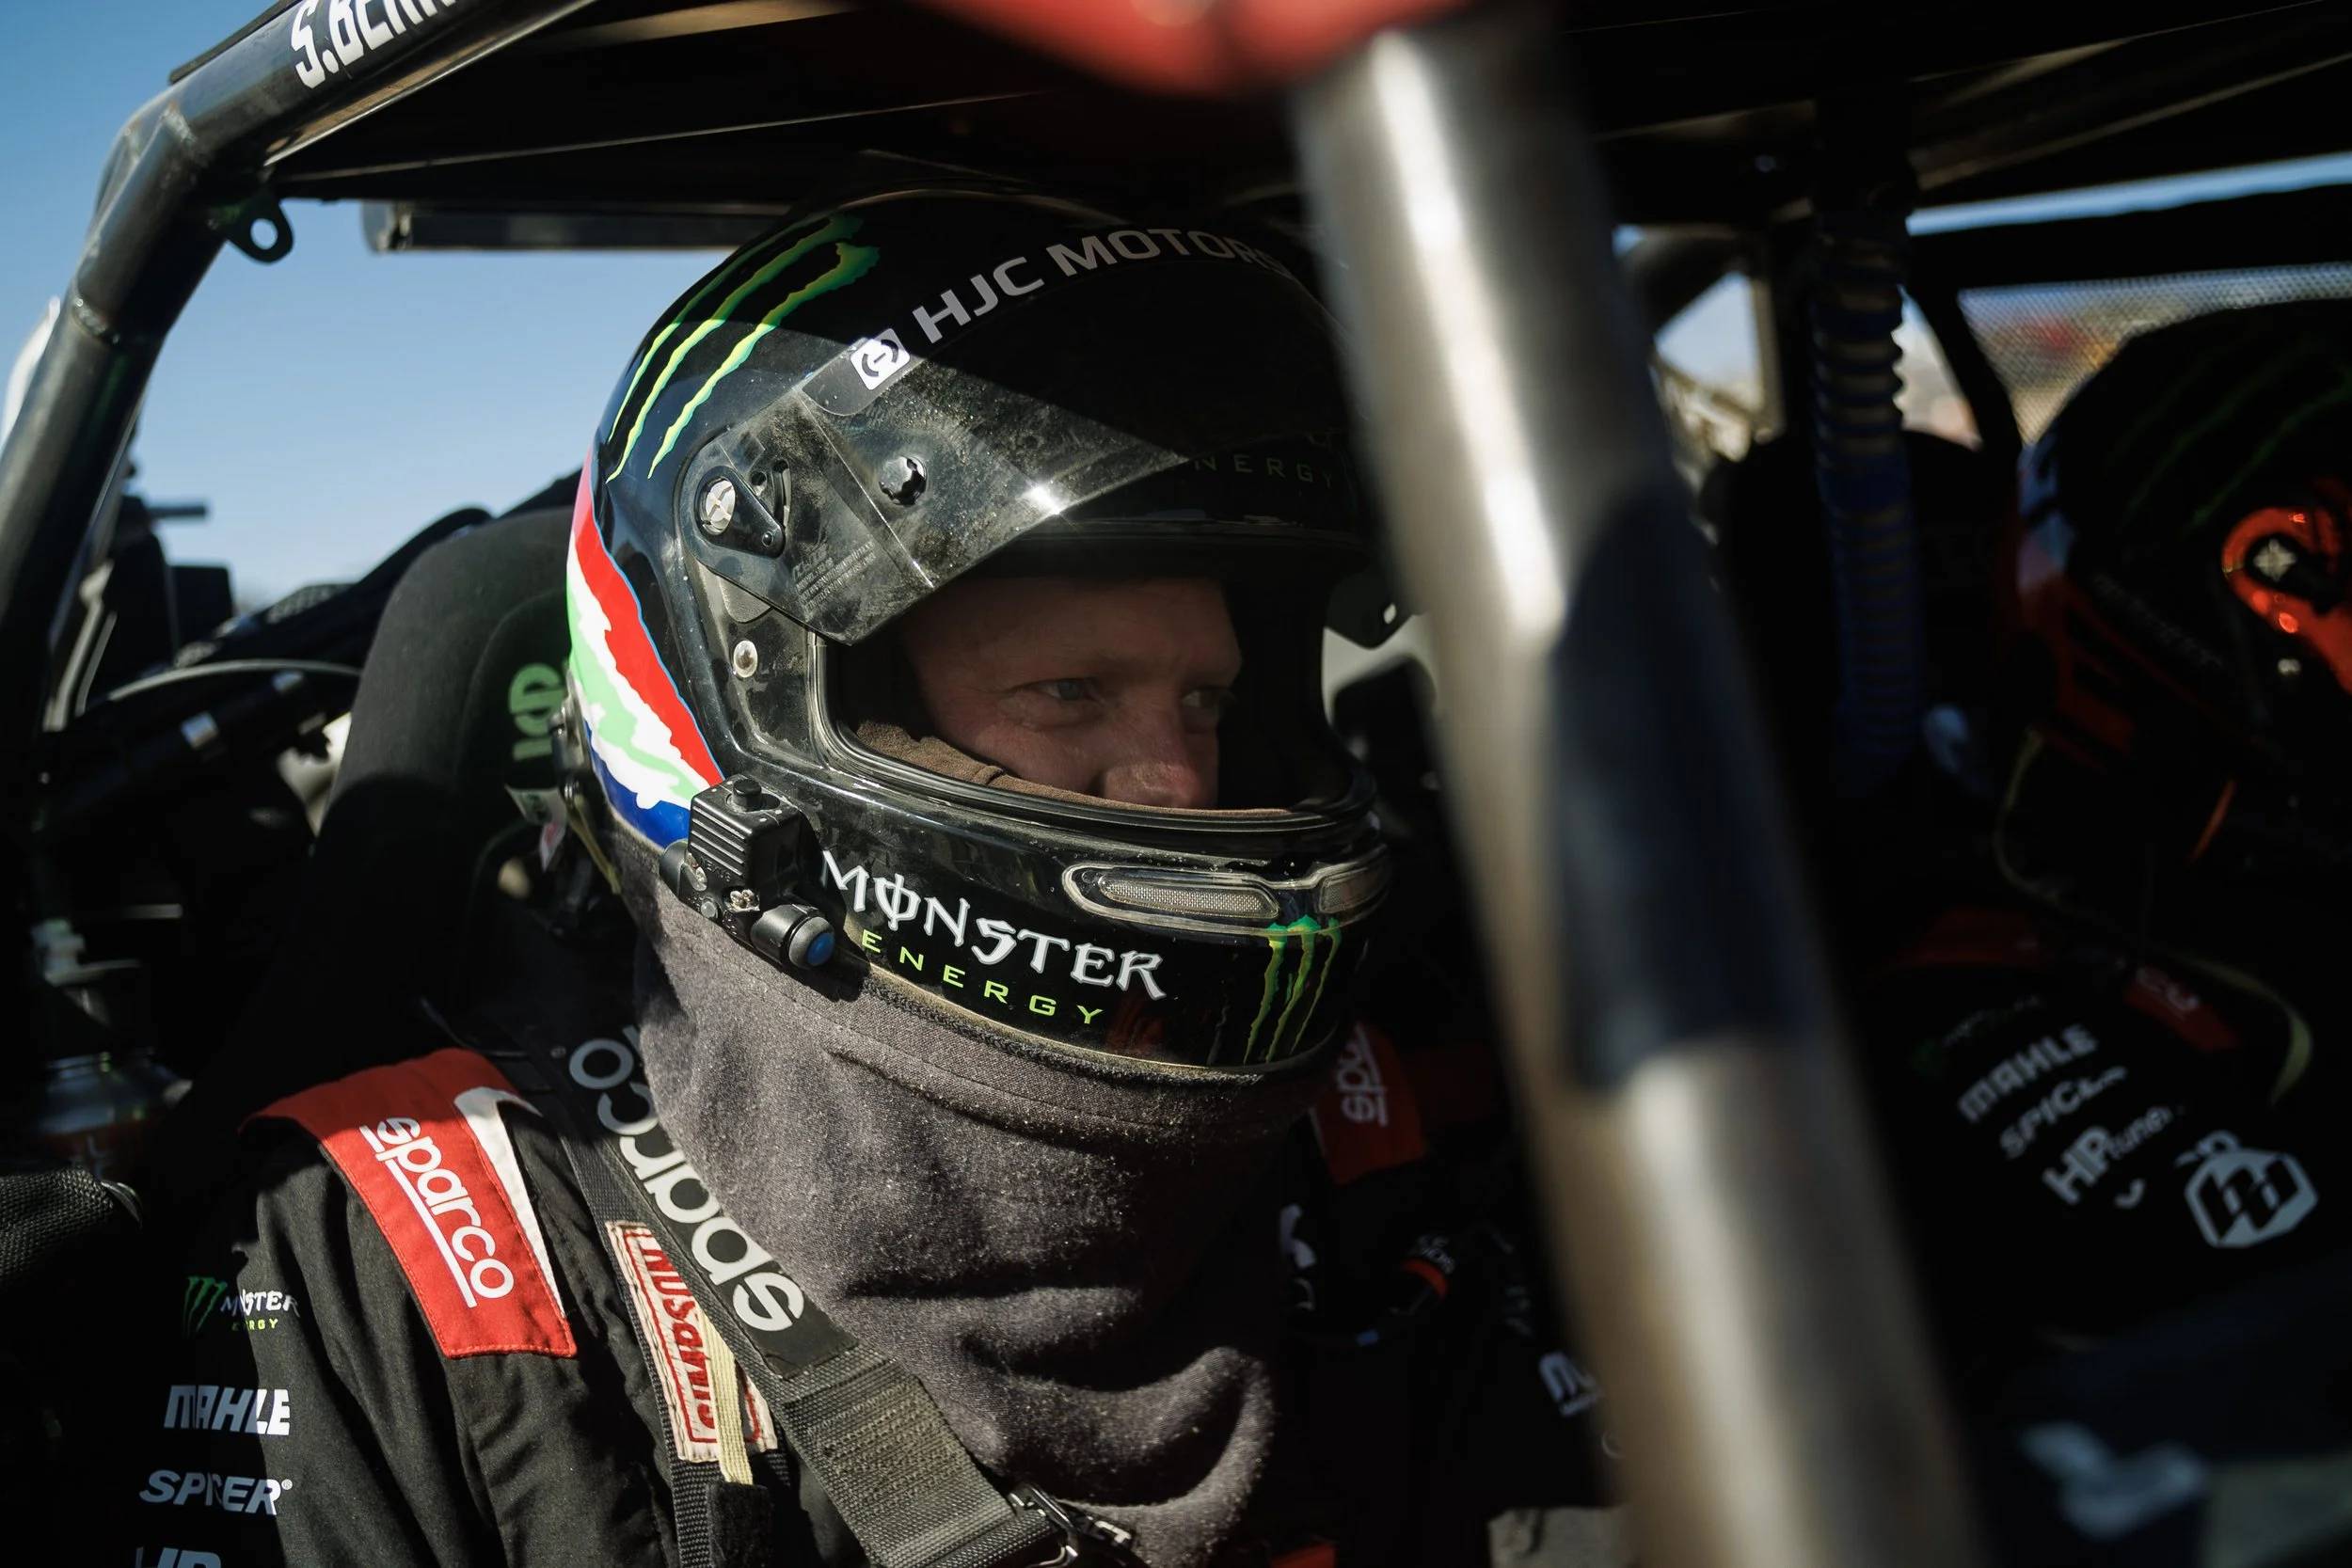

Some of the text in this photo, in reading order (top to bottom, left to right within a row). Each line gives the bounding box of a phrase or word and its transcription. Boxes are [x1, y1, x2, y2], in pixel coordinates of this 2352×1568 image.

[912, 256, 1044, 343] HJC
[1191, 452, 1334, 489] NERGY
[820, 849, 1167, 1001] MONSTER
[861, 928, 1104, 1025] ENERGY
[375, 1116, 516, 1300] sparco
[219, 1288, 302, 1318] MNSTER
[230, 1318, 279, 1333] ERGY
[162, 1384, 291, 1436] MAHLE
